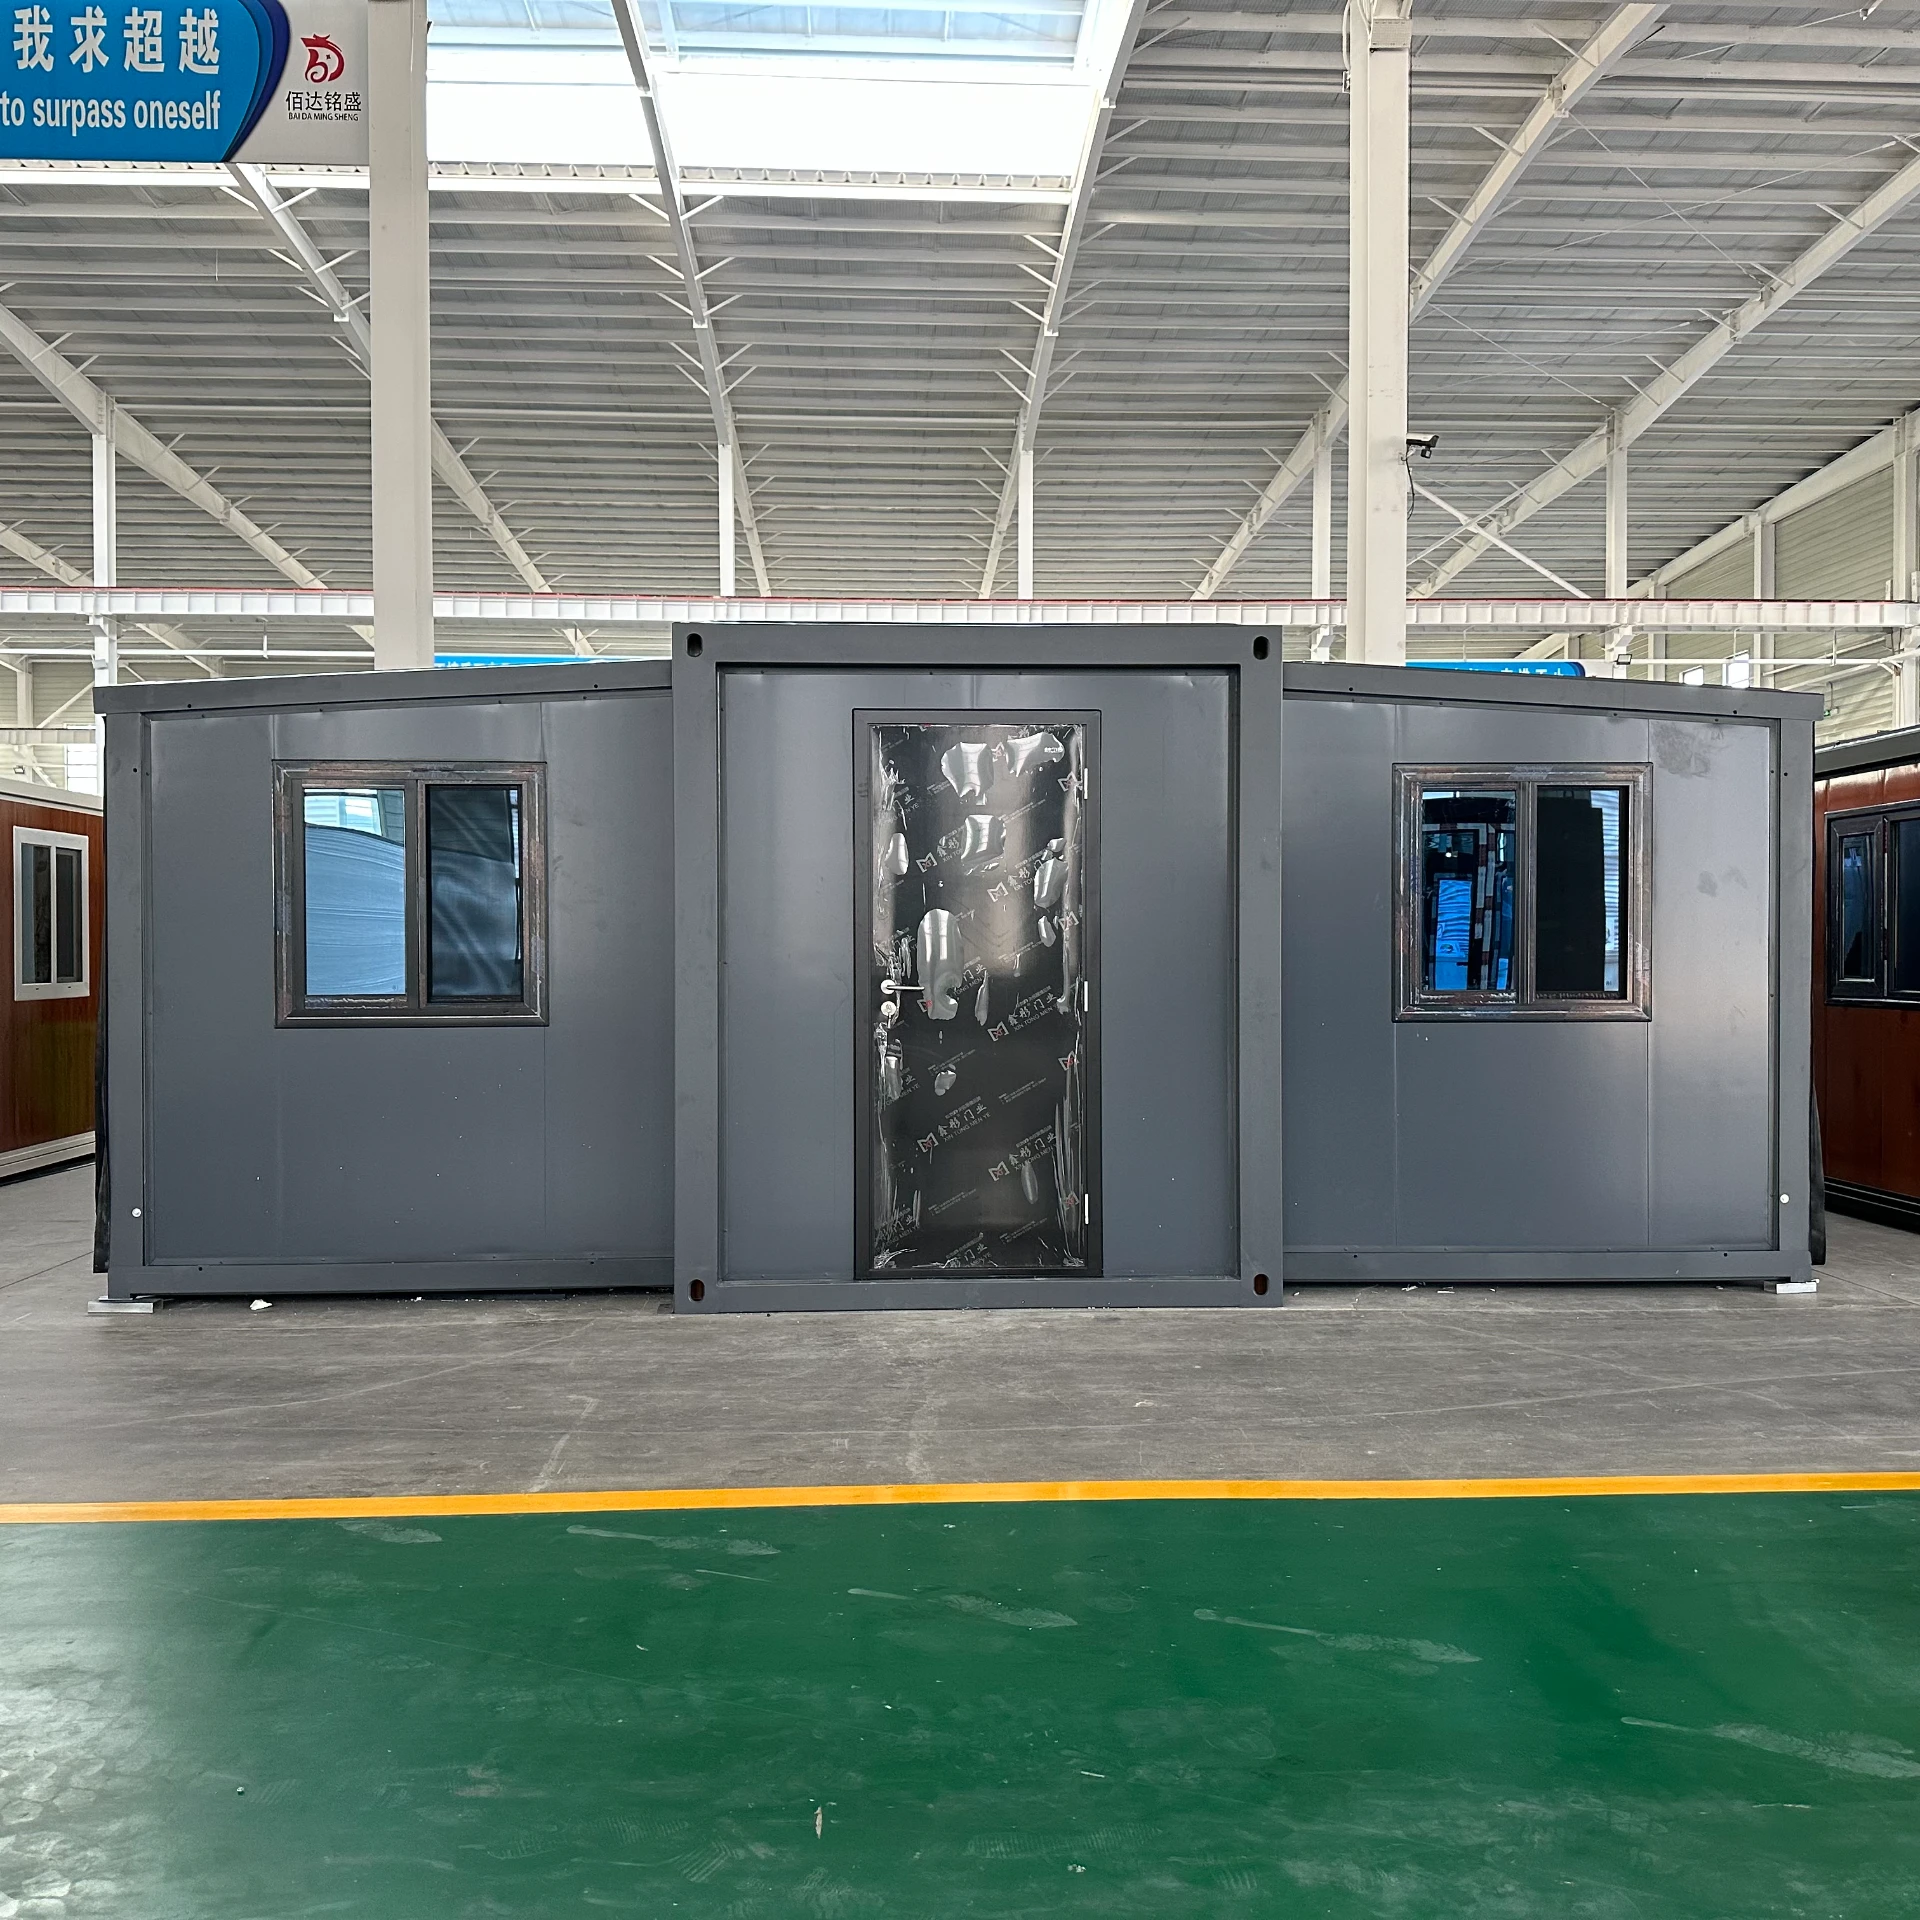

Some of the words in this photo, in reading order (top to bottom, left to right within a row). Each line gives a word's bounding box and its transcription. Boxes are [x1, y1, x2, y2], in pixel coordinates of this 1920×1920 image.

[13, 4, 221, 75] 我求超越
[0, 90, 26, 127] to
[32, 96, 127, 137] surpass
[133, 89, 221, 130] oneself
[285, 90, 362, 112] 佰达铭盛
[288, 111, 300, 120] BAI
[301, 112, 313, 120] DA
[313, 112, 334, 121] MING
[334, 112, 359, 122] SHENG
